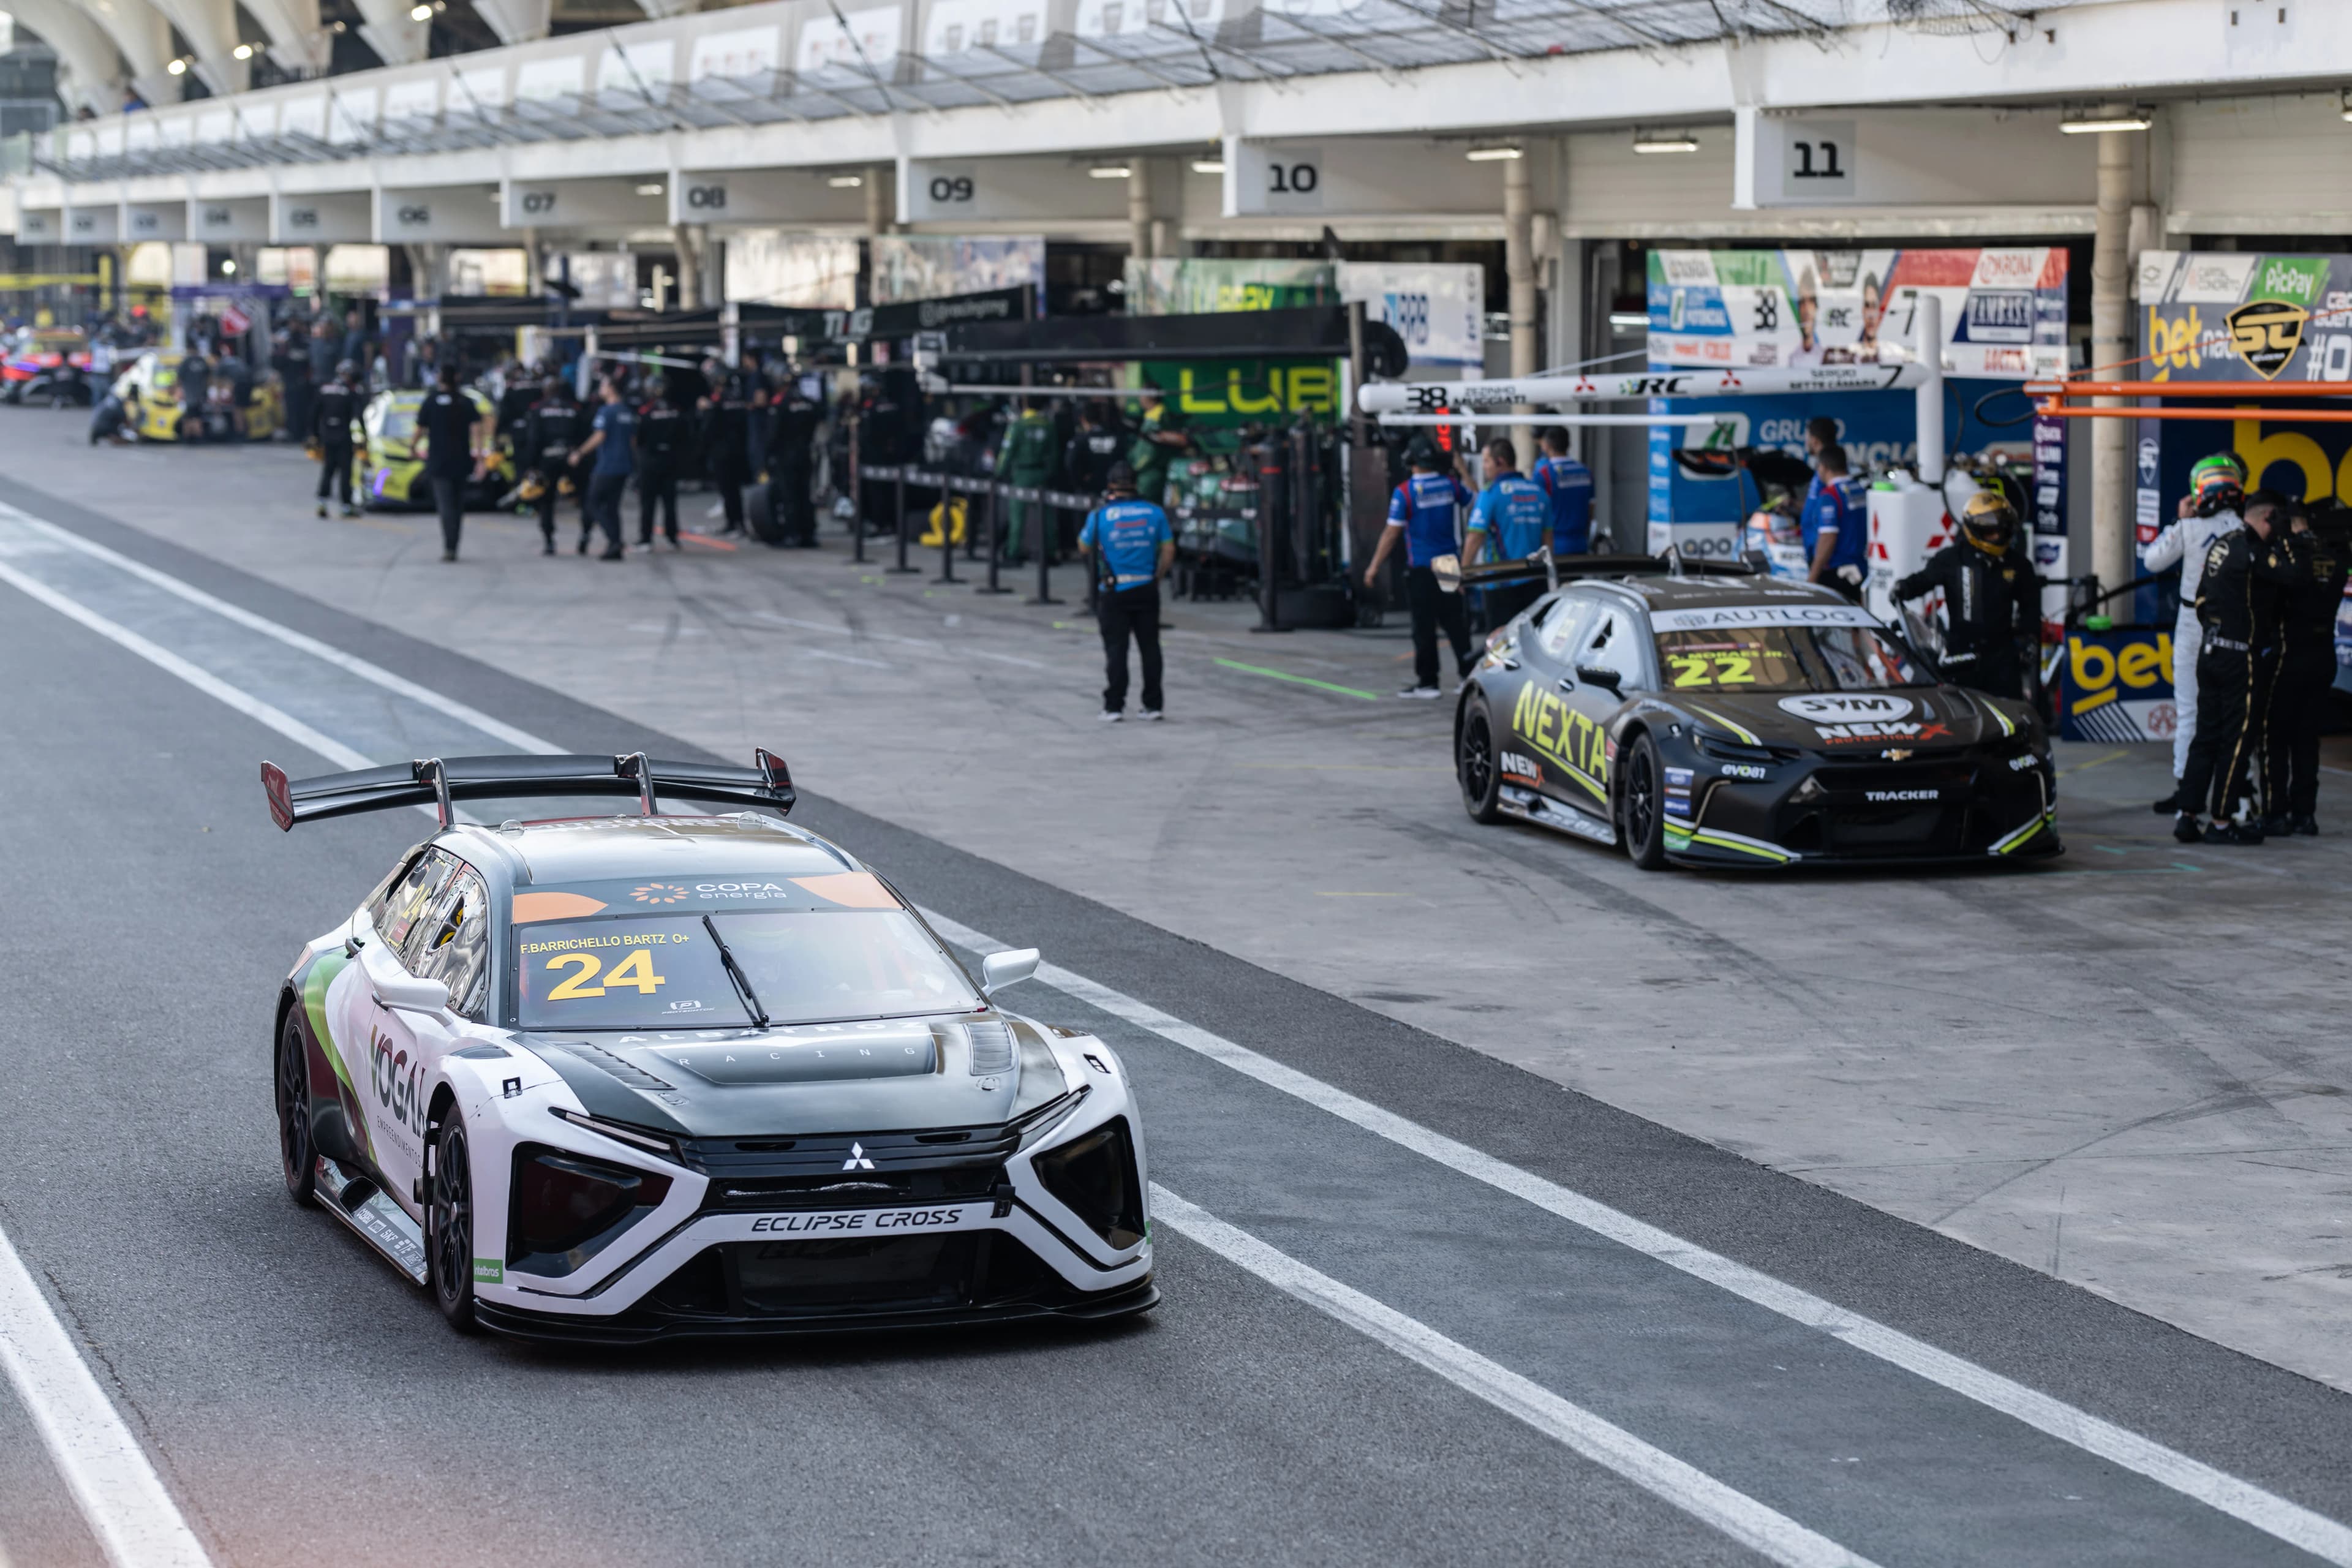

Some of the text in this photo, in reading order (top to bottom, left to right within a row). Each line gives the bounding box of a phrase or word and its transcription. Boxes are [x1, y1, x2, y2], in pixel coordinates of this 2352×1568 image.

[1793, 141, 1845, 178] 11
[929, 176, 975, 203] 09
[1269, 164, 1317, 193] 10
[522, 193, 556, 214] 07
[687, 186, 726, 209] 08
[2266, 262, 2313, 301] PicPay
[2149, 304, 2203, 369] bet
[1636, 377, 1695, 395] RC
[1879, 364, 1904, 390] 7
[1406, 387, 1449, 409] 38
[1453, 396, 1526, 407] MUGGIATI
[1759, 417, 1845, 443] GRUO
[1671, 657, 1755, 688] 22
[1512, 679, 1608, 784] NEXTA
[1825, 734, 1915, 745] PROTECTION
[1865, 790, 1939, 802] TRACKER
[695, 883, 783, 892] COPA
[699, 890, 787, 899] energia
[520, 935, 620, 954] F.BARRICHELLO
[624, 933, 666, 946] BARTZ
[545, 949, 666, 1001] 24
[619, 1022, 929, 1044] ALBATROZ
[677, 1047, 916, 1065] RACING
[751, 1208, 963, 1232] ECLIPSE CROSS
